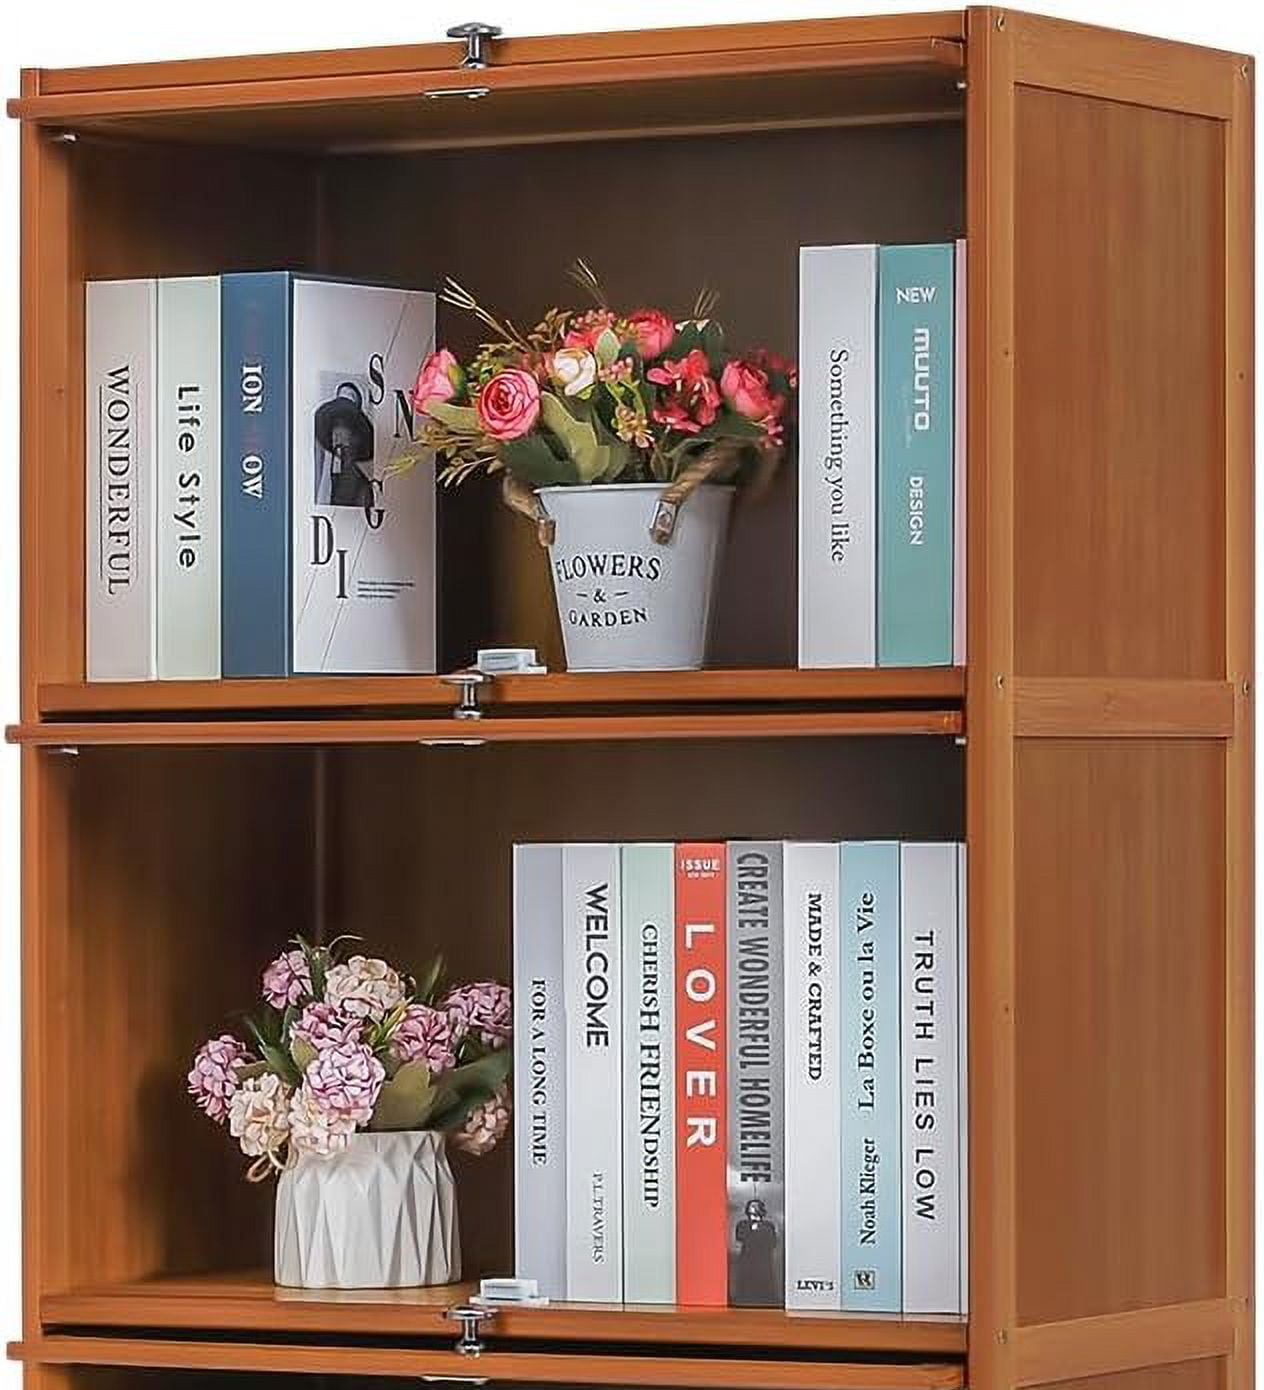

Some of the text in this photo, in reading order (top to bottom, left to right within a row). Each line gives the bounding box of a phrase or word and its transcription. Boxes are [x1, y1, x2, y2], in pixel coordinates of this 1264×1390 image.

[896, 288, 936, 303] NEW
[108, 365, 130, 595] WONDERFUL
[174, 386, 200, 568] Life Style
[241, 366, 263, 498] ION OW
[825, 349, 848, 563] Something you like
[909, 476, 923, 545] DESIGN
[556, 553, 661, 581] FLOWERS
[569, 608, 648, 627] GARDEN
[682, 858, 720, 871] ISSUE
[585, 883, 609, 1048] WELCOME
[685, 924, 716, 1148] LOVER
[737, 852, 771, 1182] CREATE WONDERFUL HOMELIFE
[809, 892, 822, 1080] MADE & CRAFTED
[857, 892, 874, 1110] La Boxe ou la Vie
[532, 979, 546, 1164] FOR A LONG TIME
[641, 924, 660, 1208] CHERISH FRIENDSHIP
[914, 930, 935, 1220] TRUTH LIES LOW
[860, 1137, 880, 1245] Noah Klieger
